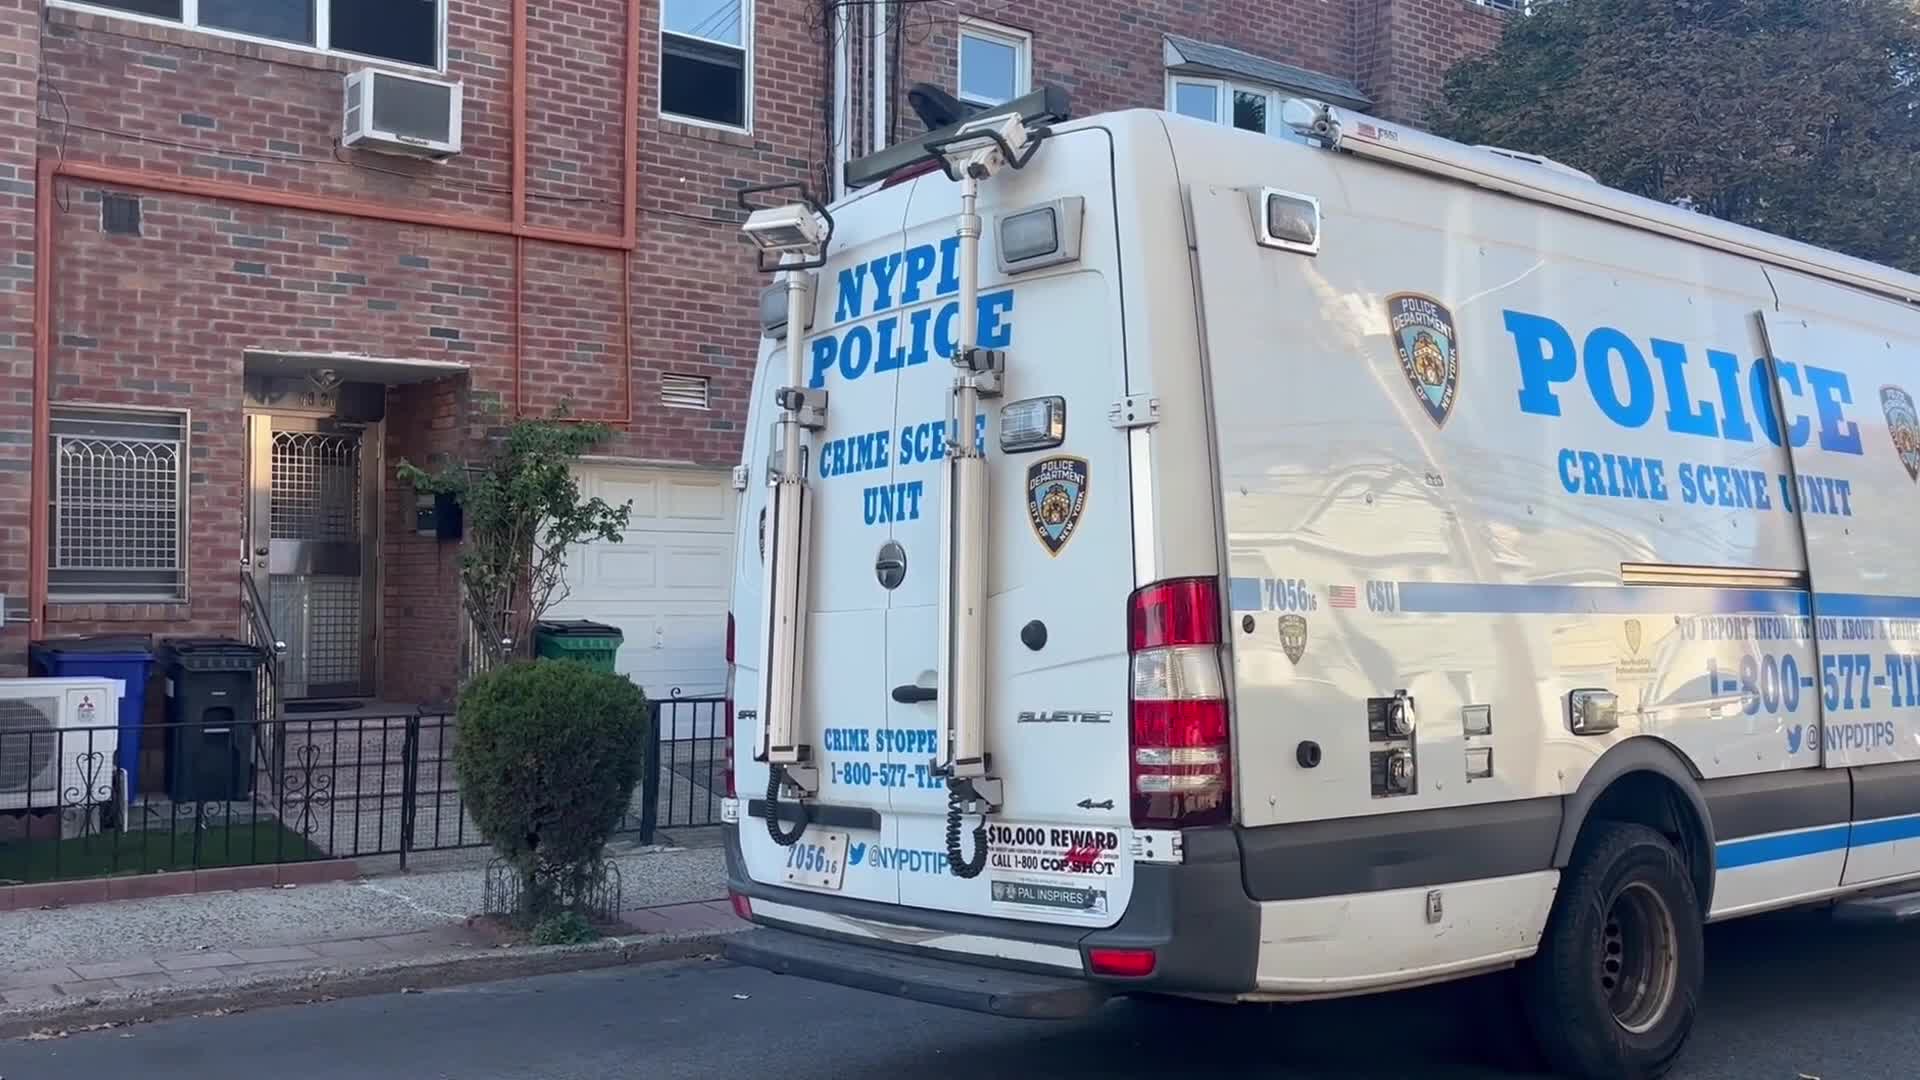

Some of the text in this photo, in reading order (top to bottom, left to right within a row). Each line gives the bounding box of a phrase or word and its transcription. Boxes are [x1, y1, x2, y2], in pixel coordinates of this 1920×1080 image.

[1401, 298, 1438, 318] POLICE
[1392, 312, 1453, 338] DEPARTMENT
[809, 290, 1015, 389] POLICE
[1502, 309, 1864, 456] POLICE
[819, 430, 890, 479] CRIME
[1042, 461, 1074, 473] POLICE
[1030, 469, 1085, 489] DEPARTMENT
[1557, 447, 1669, 501] CRIME
[1679, 462, 1772, 511] SCENE
[863, 481, 923, 526] UNIT
[1060, 521, 1074, 540] NEW
[1366, 580, 1395, 612] CSU
[1701, 615, 1750, 641] REPORT
[1841, 617, 1875, 641] ABOUT
[824, 728, 938, 753] CRIME STOPPE
[988, 824, 1118, 851] $10,000 REWARD
[868, 844, 949, 875] @NYPDTIP
[991, 853, 1012, 868] CALL
[1015, 855, 1039, 870] 1-800
[1018, 887, 1084, 904] PAL INSPIRES
